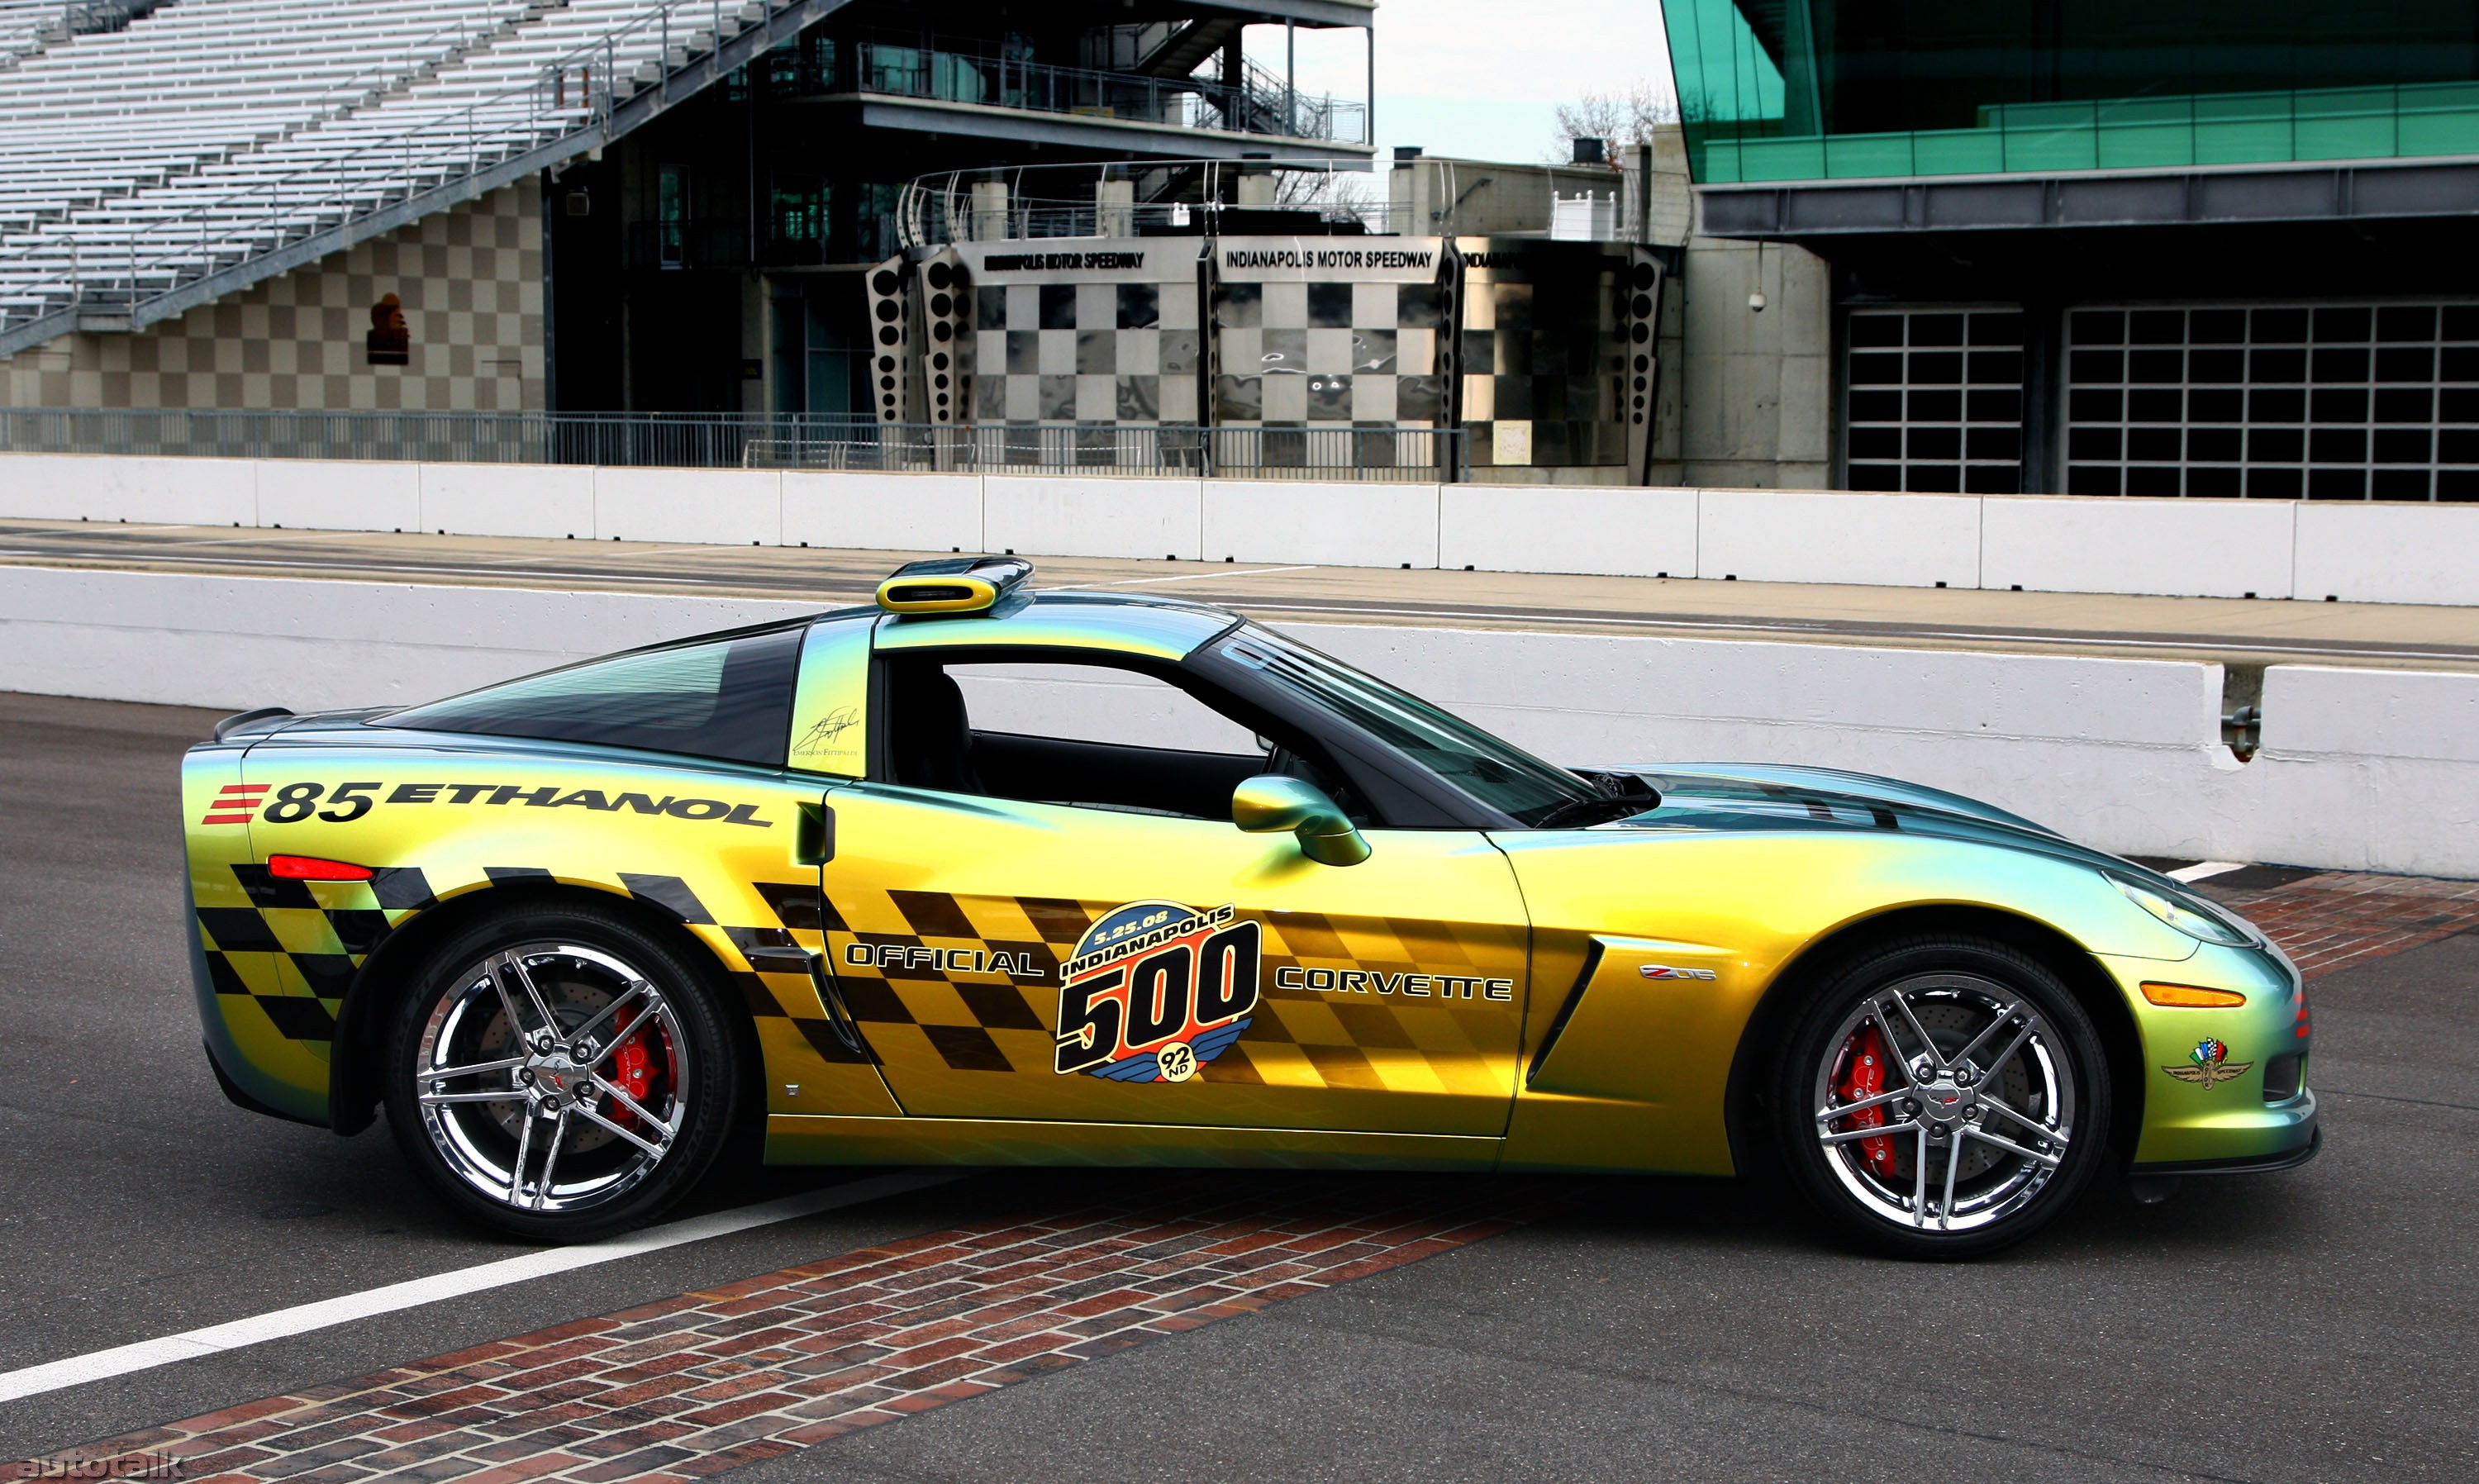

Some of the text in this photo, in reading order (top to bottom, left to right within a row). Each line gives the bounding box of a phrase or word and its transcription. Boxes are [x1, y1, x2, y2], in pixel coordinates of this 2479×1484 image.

[1084, 252, 1144, 269] SPEEDWAY
[1226, 250, 1433, 268] INDIANAPOLIS MOTOR SPEEDWAY
[385, 782, 773, 828] ETHANOL
[1060, 905, 1234, 978] INDIANAPOLIS
[1093, 910, 1168, 946] 5.25.08
[845, 943, 1044, 977] OFFICIAL
[1056, 920, 1260, 1073] 500
[1275, 966, 1513, 1001] CORVETTE
[1160, 1046, 1191, 1070] 92
[1168, 1063, 1188, 1077] ND
